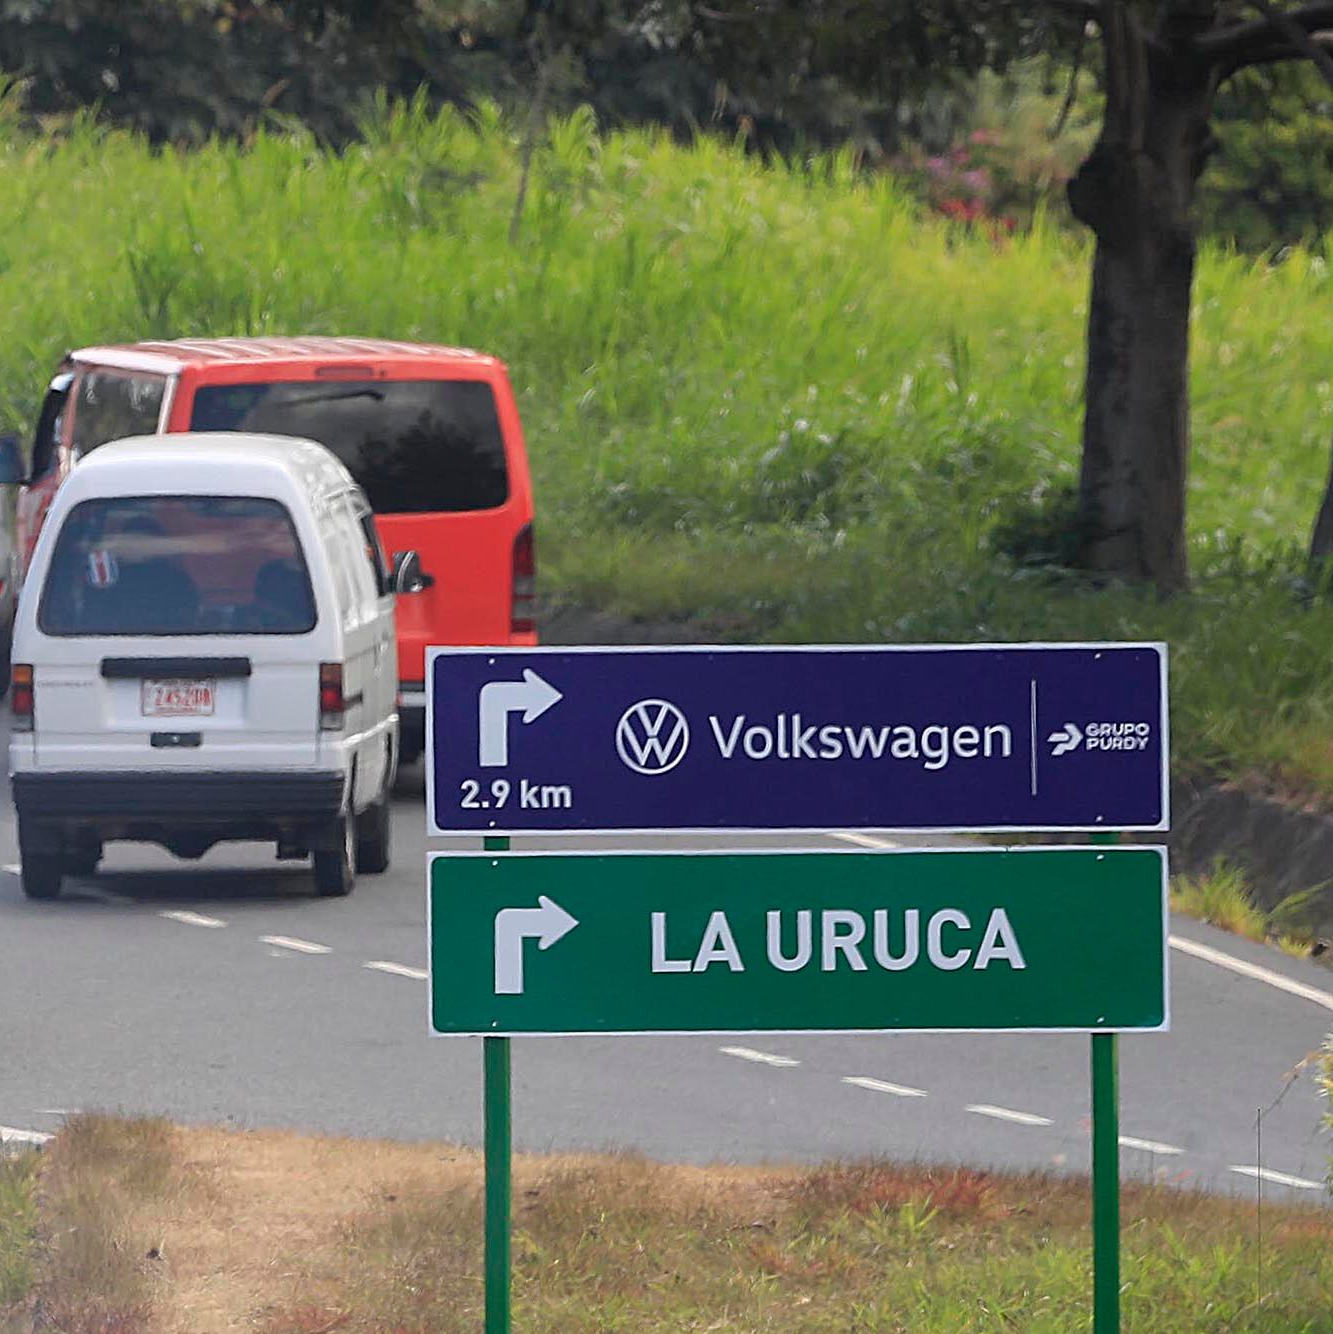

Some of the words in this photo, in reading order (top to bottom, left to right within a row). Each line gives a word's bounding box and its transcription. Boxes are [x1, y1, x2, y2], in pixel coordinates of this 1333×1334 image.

[709, 713, 1011, 770] Volkswagen
[1085, 723, 1150, 736] GRUPO
[1085, 737, 1149, 750] PURDY
[460, 779, 511, 808] 2.9
[520, 779, 572, 808] km
[651, 911, 745, 973] LA
[766, 908, 1026, 972] URUCA
